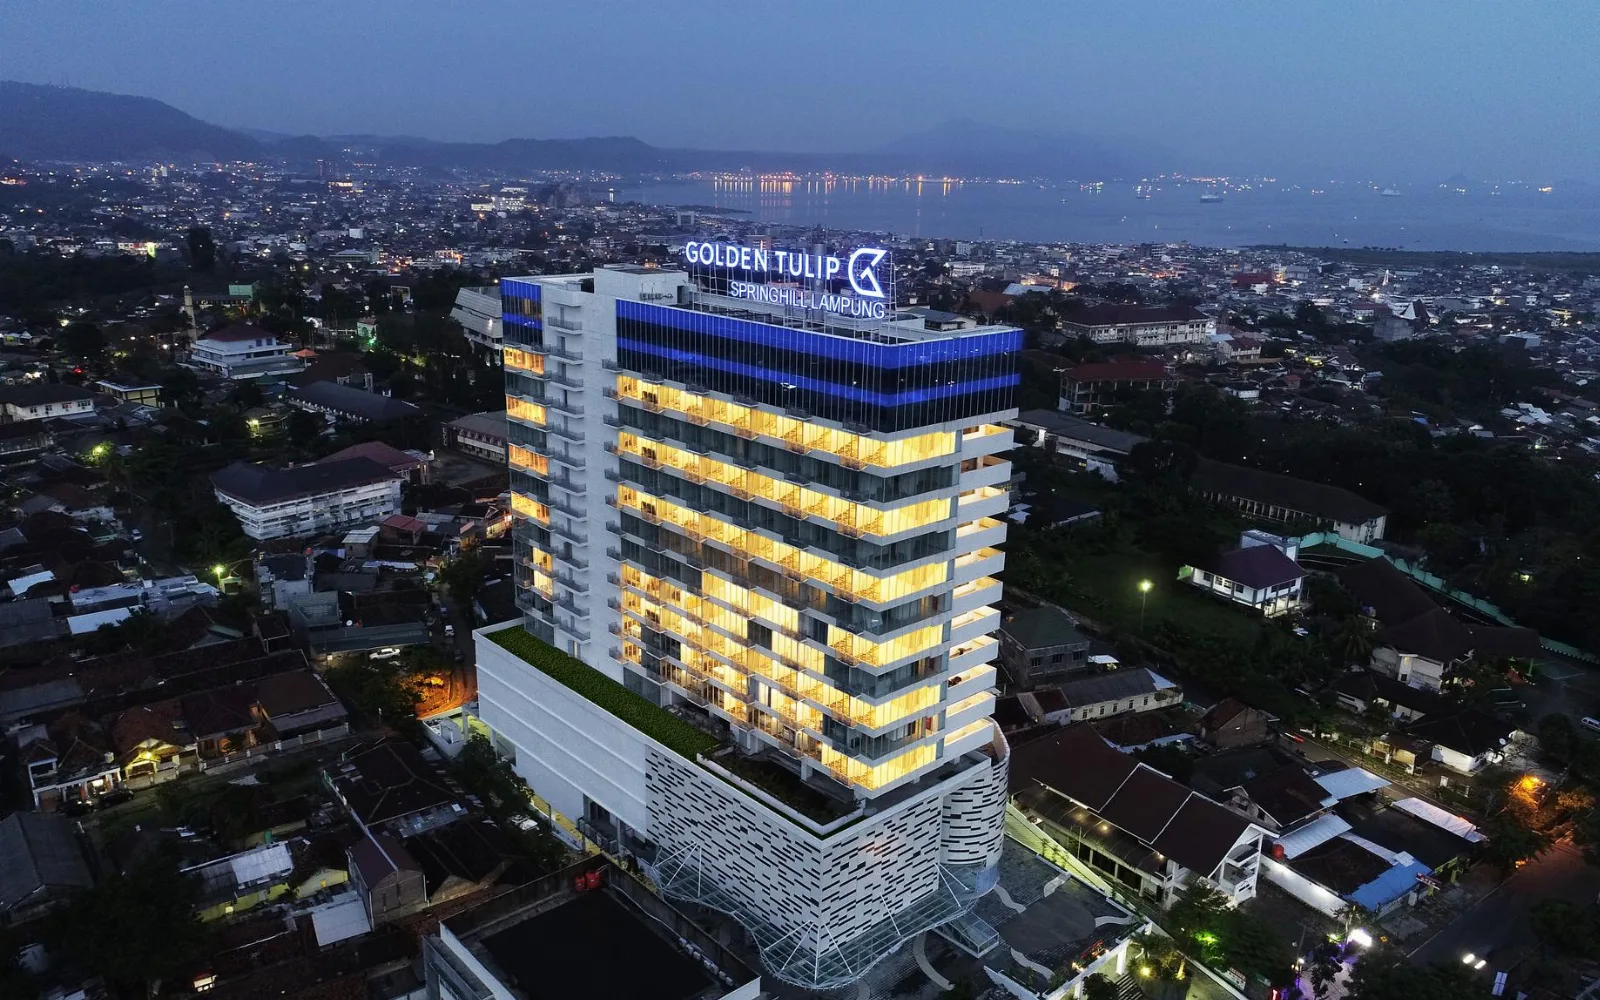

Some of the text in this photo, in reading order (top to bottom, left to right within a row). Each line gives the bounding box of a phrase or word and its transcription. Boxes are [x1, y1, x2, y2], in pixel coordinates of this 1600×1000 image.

[685, 241, 840, 280] GOLDEN TULIP
[730, 282, 885, 319] SPRINGHILL LAMPUNG
